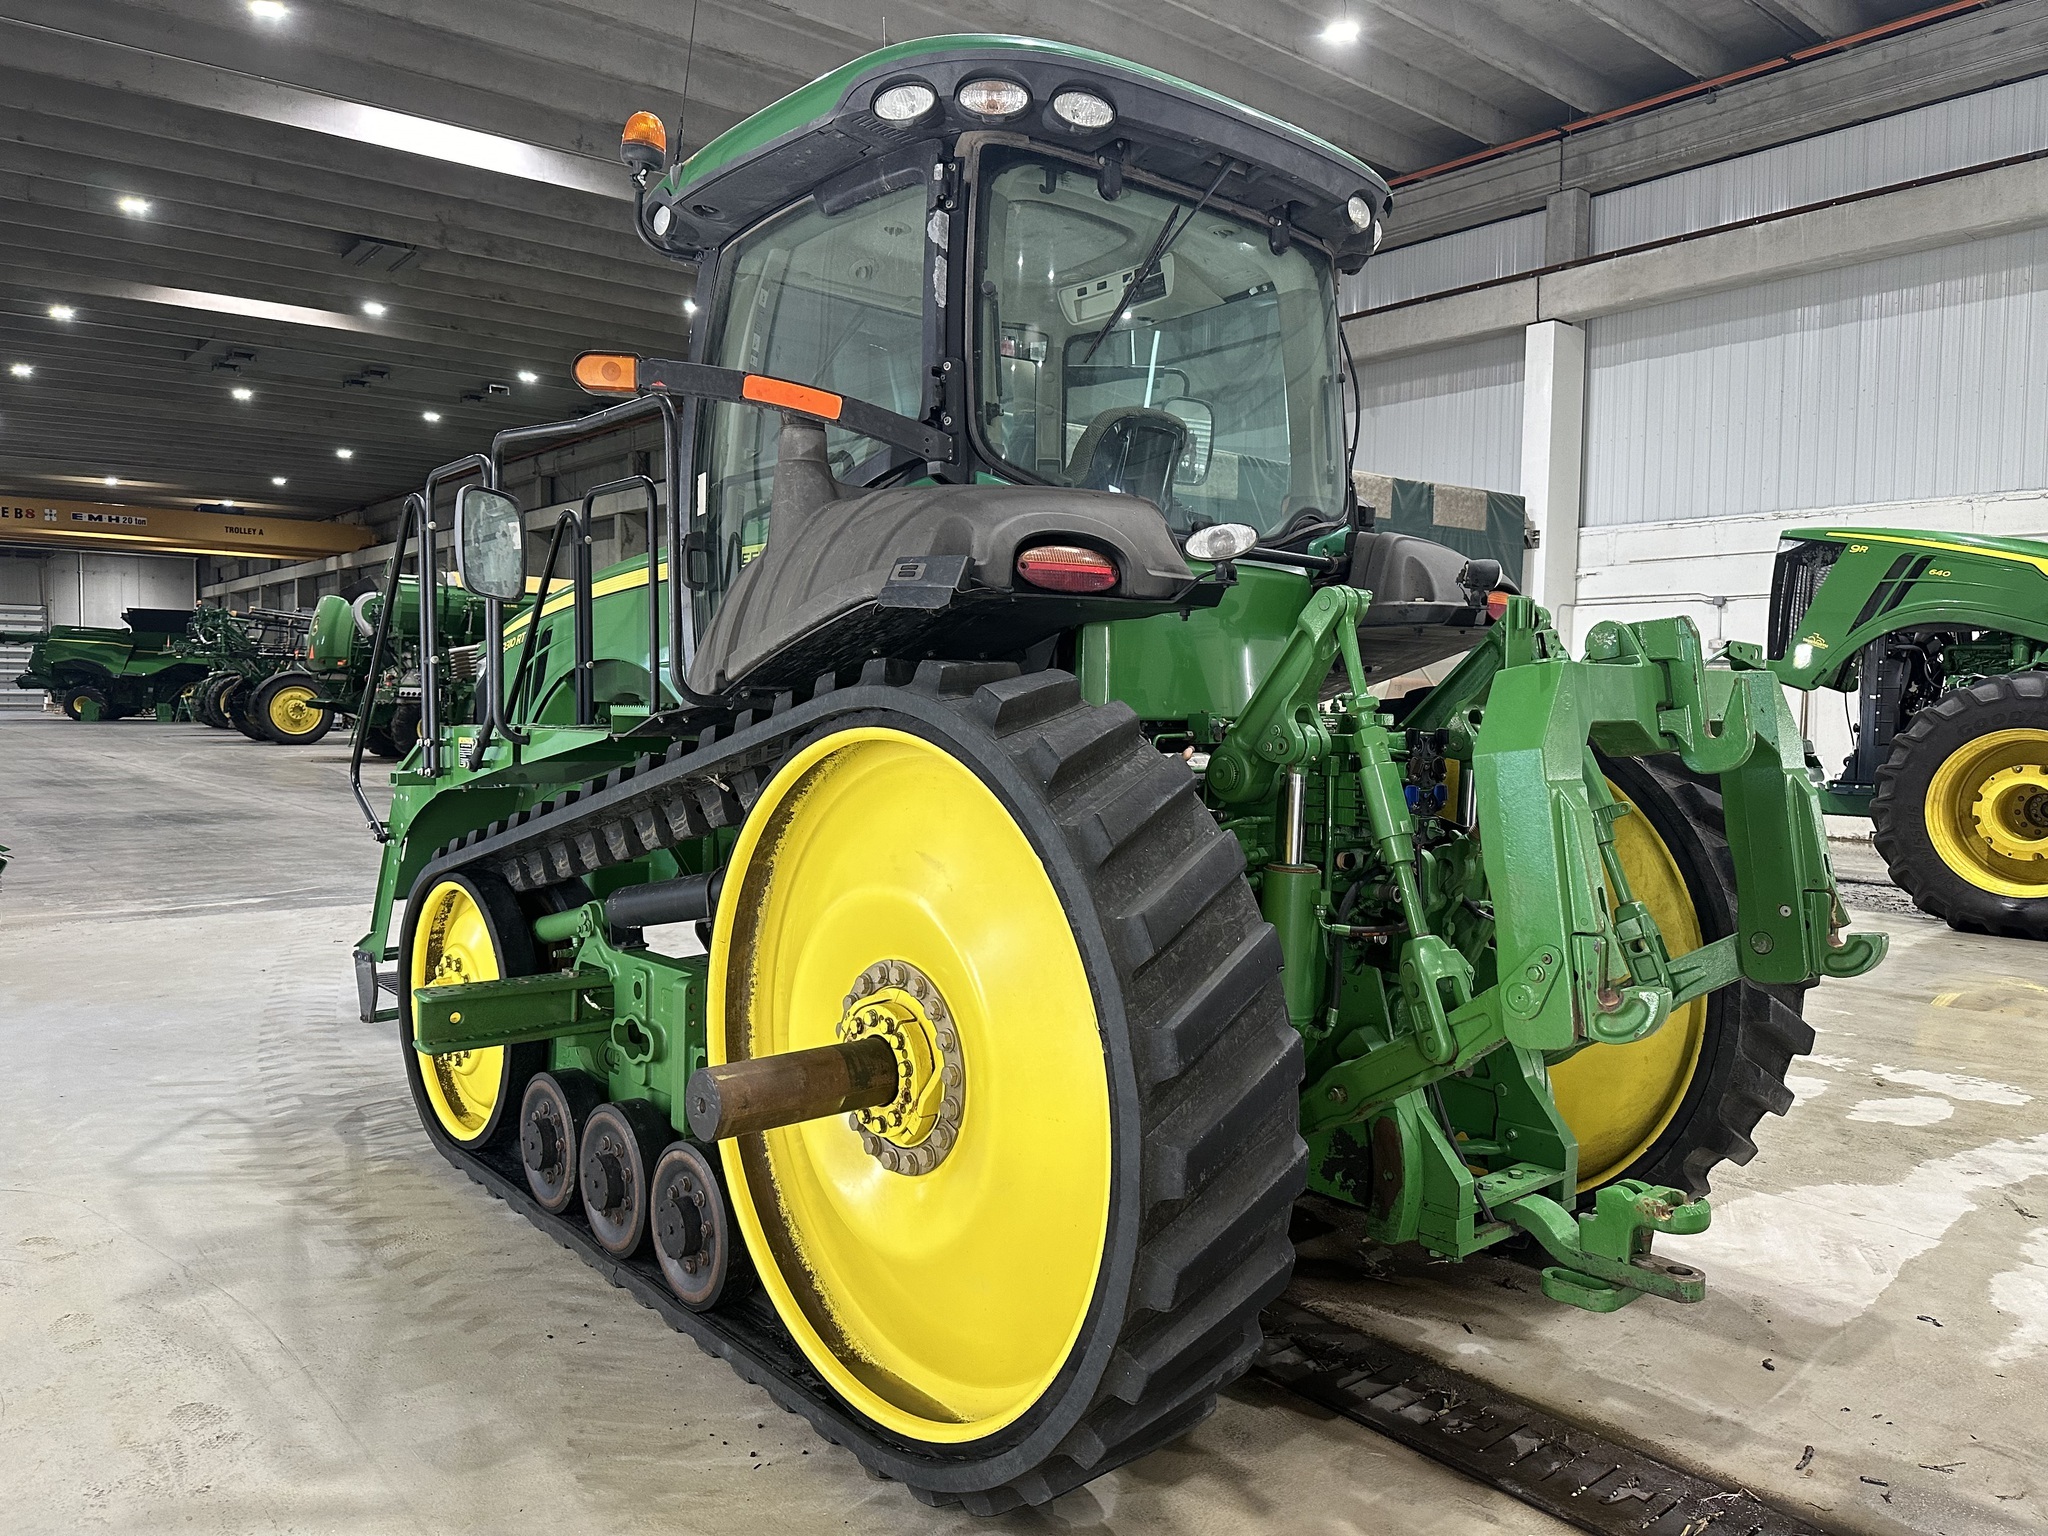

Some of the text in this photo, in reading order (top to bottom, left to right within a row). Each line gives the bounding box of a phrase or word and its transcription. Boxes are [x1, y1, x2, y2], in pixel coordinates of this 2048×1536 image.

[224, 526, 257, 535] TROLLEY
[1849, 545, 1869, 553] 9R
[1928, 569, 1951, 577] 640
